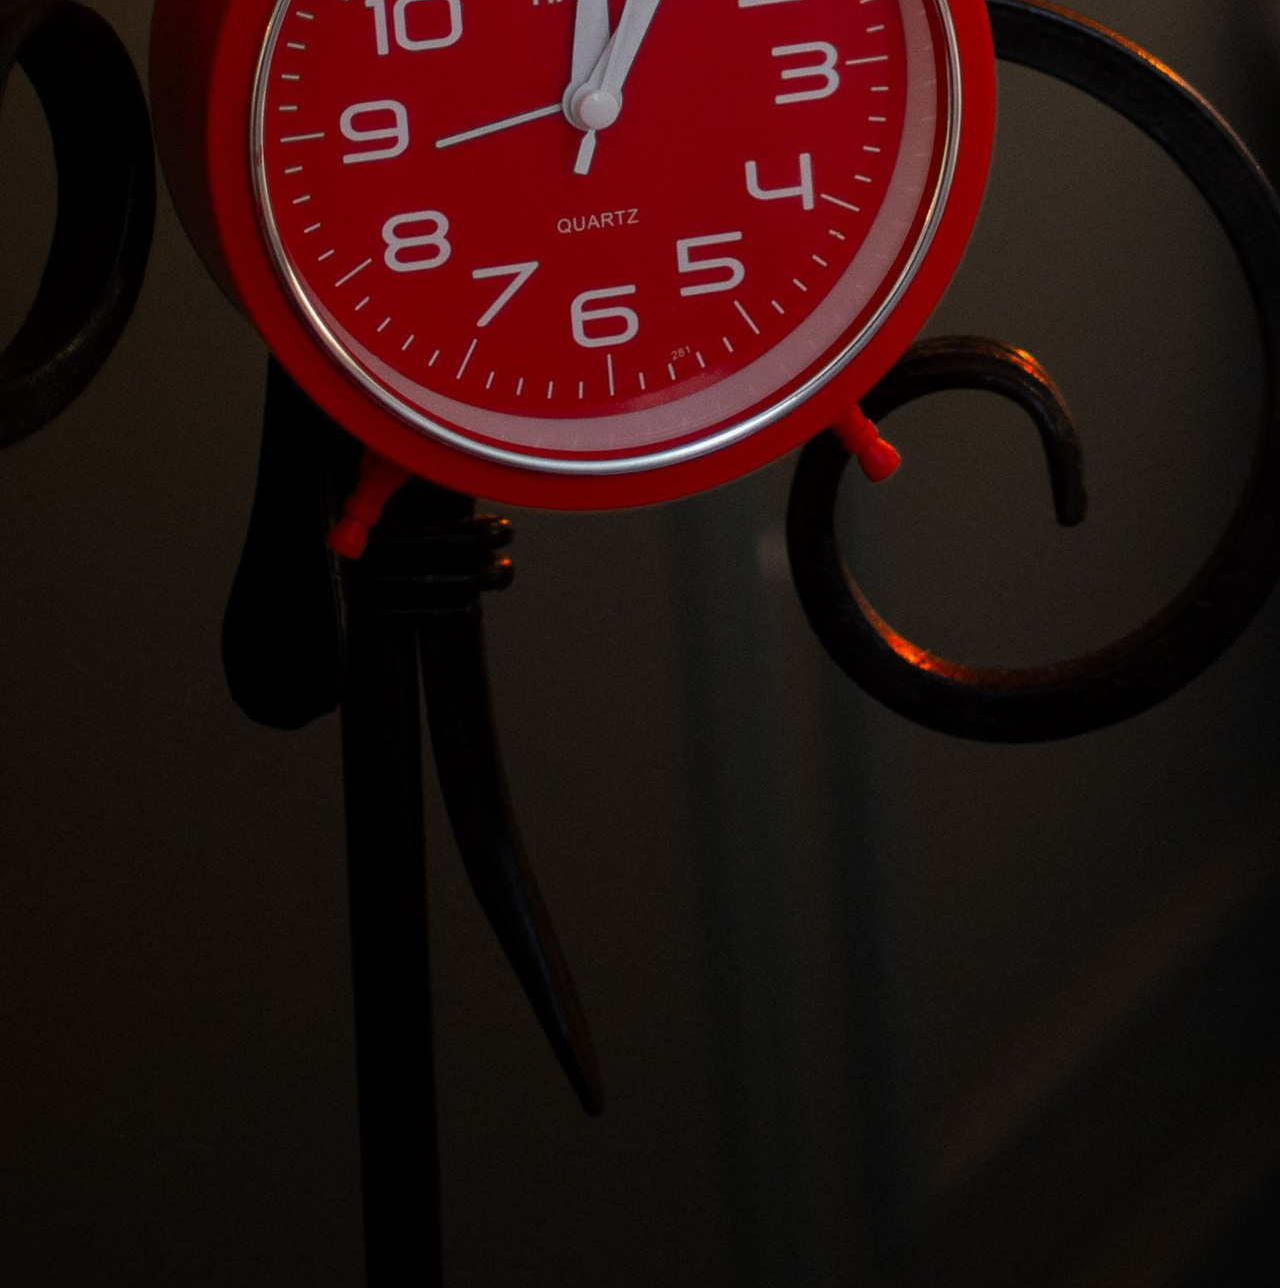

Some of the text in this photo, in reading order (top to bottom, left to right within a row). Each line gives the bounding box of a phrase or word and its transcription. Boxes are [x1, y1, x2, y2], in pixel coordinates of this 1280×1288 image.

[771, 41, 840, 105] 3
[340, 99, 409, 164] 9
[745, 152, 814, 211] 4
[382, 210, 451, 272] 8
[557, 208, 640, 234] QUARTZ
[472, 261, 539, 327] 7
[676, 231, 745, 297] 5
[571, 284, 639, 348] 6
